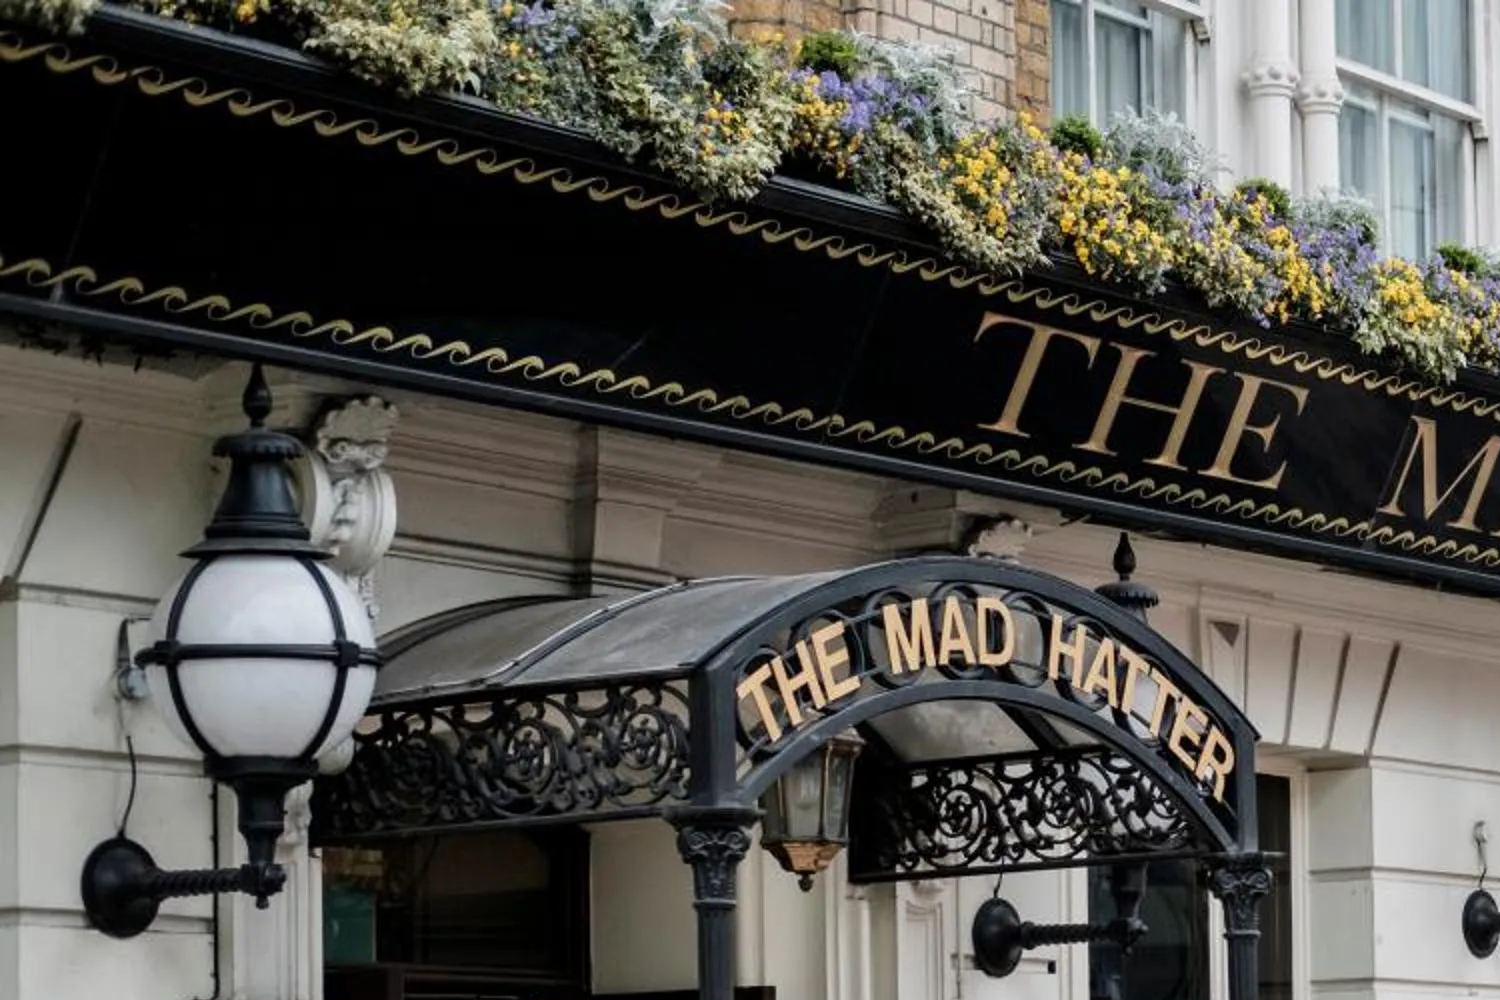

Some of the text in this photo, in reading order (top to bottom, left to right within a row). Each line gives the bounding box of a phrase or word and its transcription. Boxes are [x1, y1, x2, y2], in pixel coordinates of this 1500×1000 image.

[973, 310, 1310, 491] THE
[735, 595, 1237, 803] THE MAD HATTER
